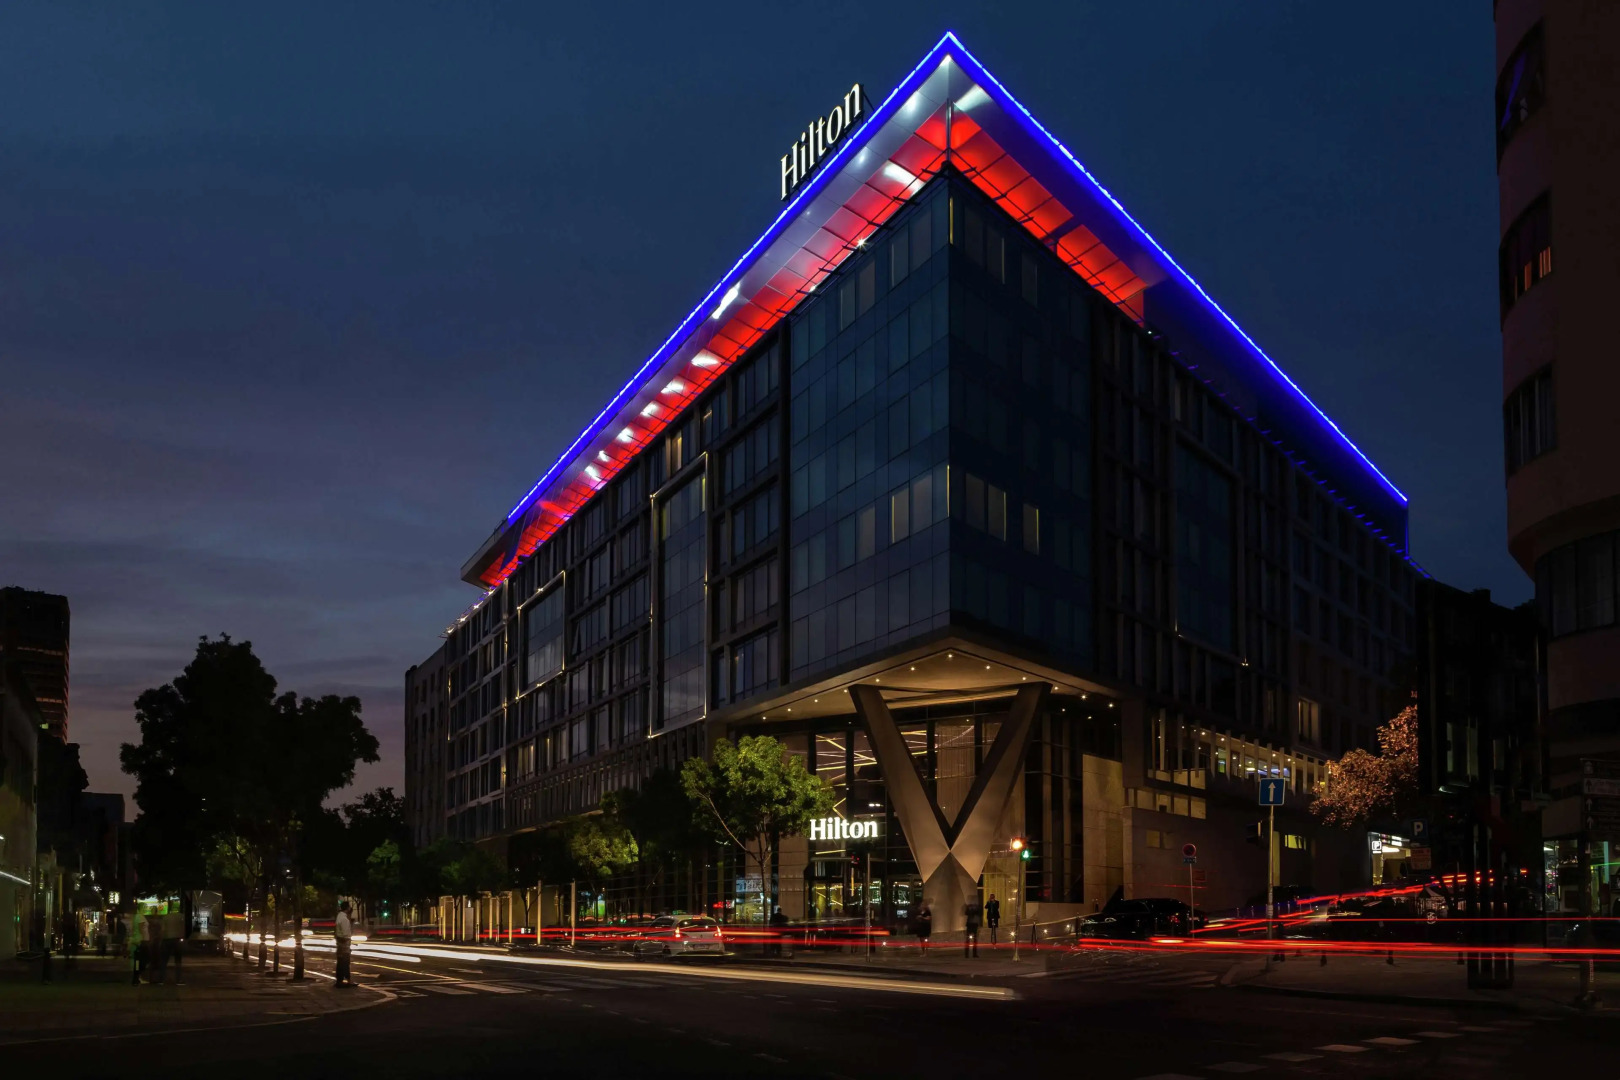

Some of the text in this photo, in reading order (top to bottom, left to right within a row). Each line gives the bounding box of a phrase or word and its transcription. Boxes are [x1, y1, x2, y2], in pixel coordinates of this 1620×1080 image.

[781, 83, 861, 200] Hilton
[809, 817, 878, 840] Hilton
[1413, 821, 1423, 836] P
